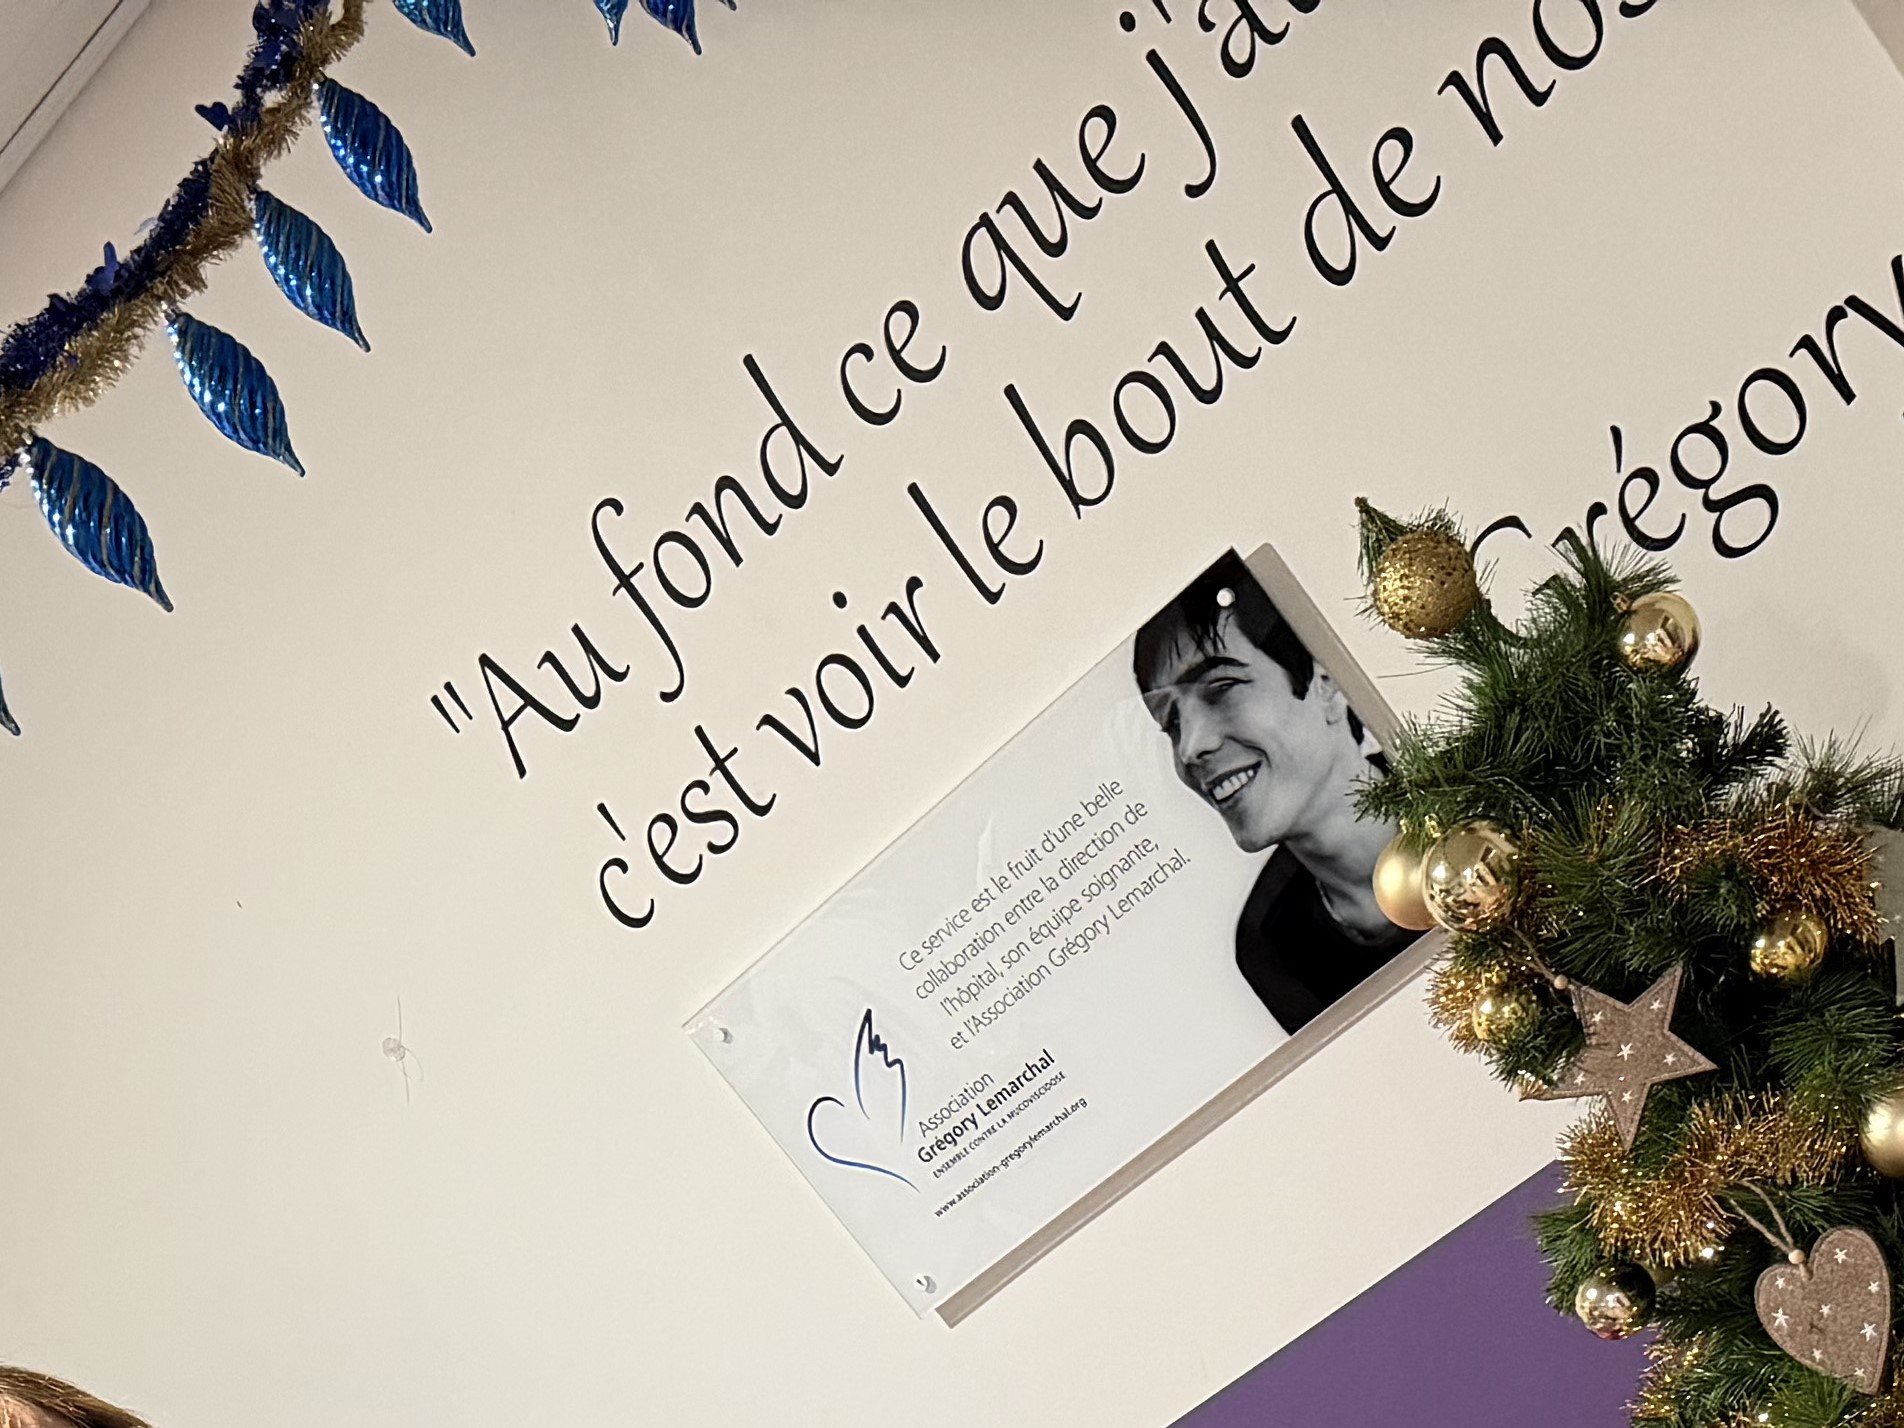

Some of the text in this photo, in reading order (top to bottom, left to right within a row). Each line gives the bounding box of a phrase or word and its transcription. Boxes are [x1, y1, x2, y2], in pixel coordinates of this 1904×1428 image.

[431, 0, 1323, 780] "Au fond ce que j'a
[598, 803, 778, 929] c'est
[756, 576, 942, 767] voir
[907, 482, 1045, 606] le
[1003, 238, 1297, 520] bout
[1291, 113, 1442, 286] de
[899, 778, 1124, 972] Ce service est le fruit d'une belle
[915, 799, 1149, 1000] collaboration entre la direction de
[940, 836, 1160, 1017] l'hôpital, son équipe soignante,
[950, 847, 1192, 1050] et l'Association Grégory Lemarchal.
[917, 1048, 1056, 1164] Grégory Lemarchal
[918, 1072, 996, 1138] Association
[997, 1117, 1009, 1129] LA
